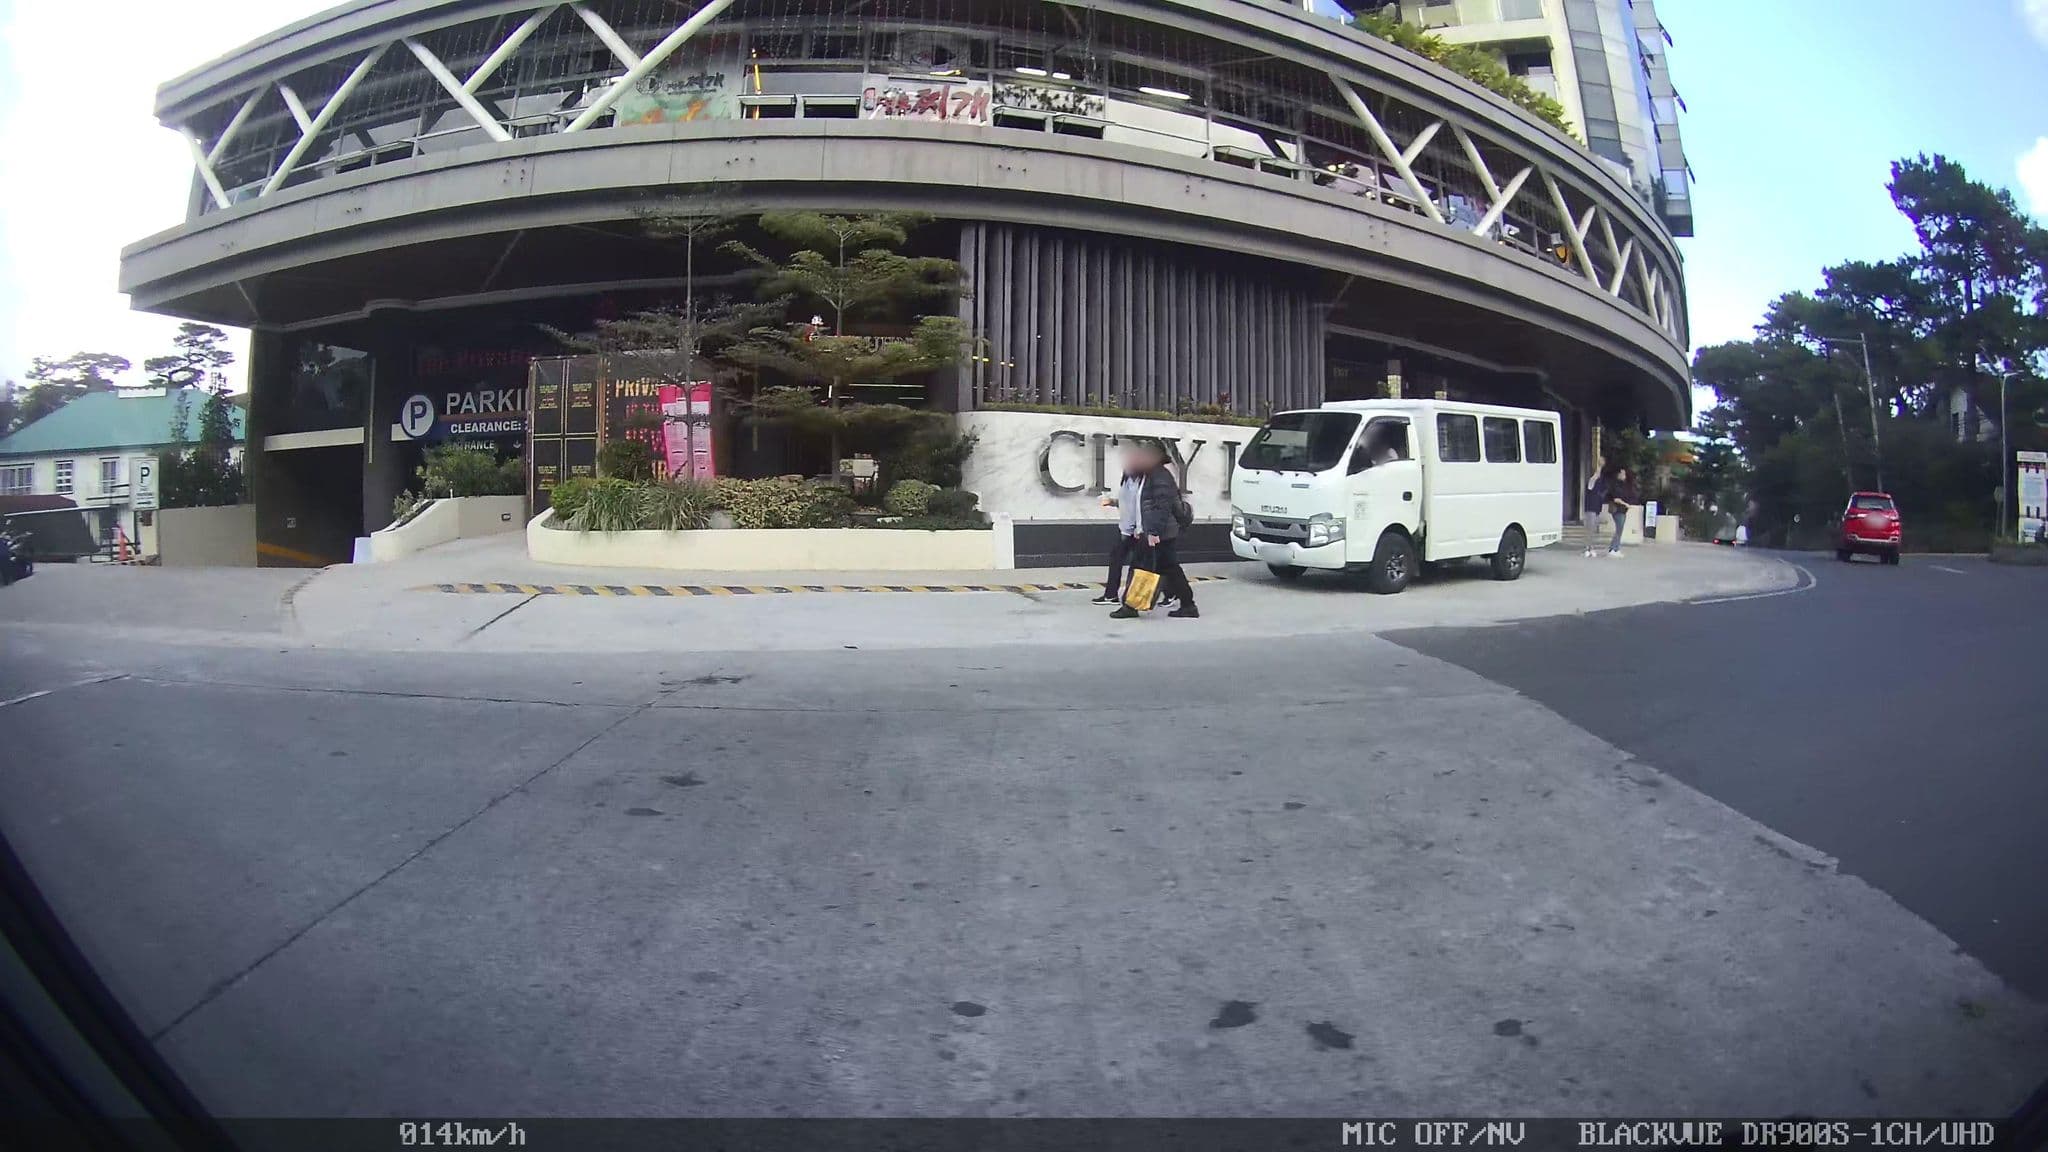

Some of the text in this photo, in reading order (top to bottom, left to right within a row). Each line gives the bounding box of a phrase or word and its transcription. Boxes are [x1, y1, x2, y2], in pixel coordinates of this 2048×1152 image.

[446, 388, 529, 415] PARKI
[410, 400, 428, 430] P
[450, 420, 522, 434] CLEARANCE:
[140, 466, 151, 484] P
